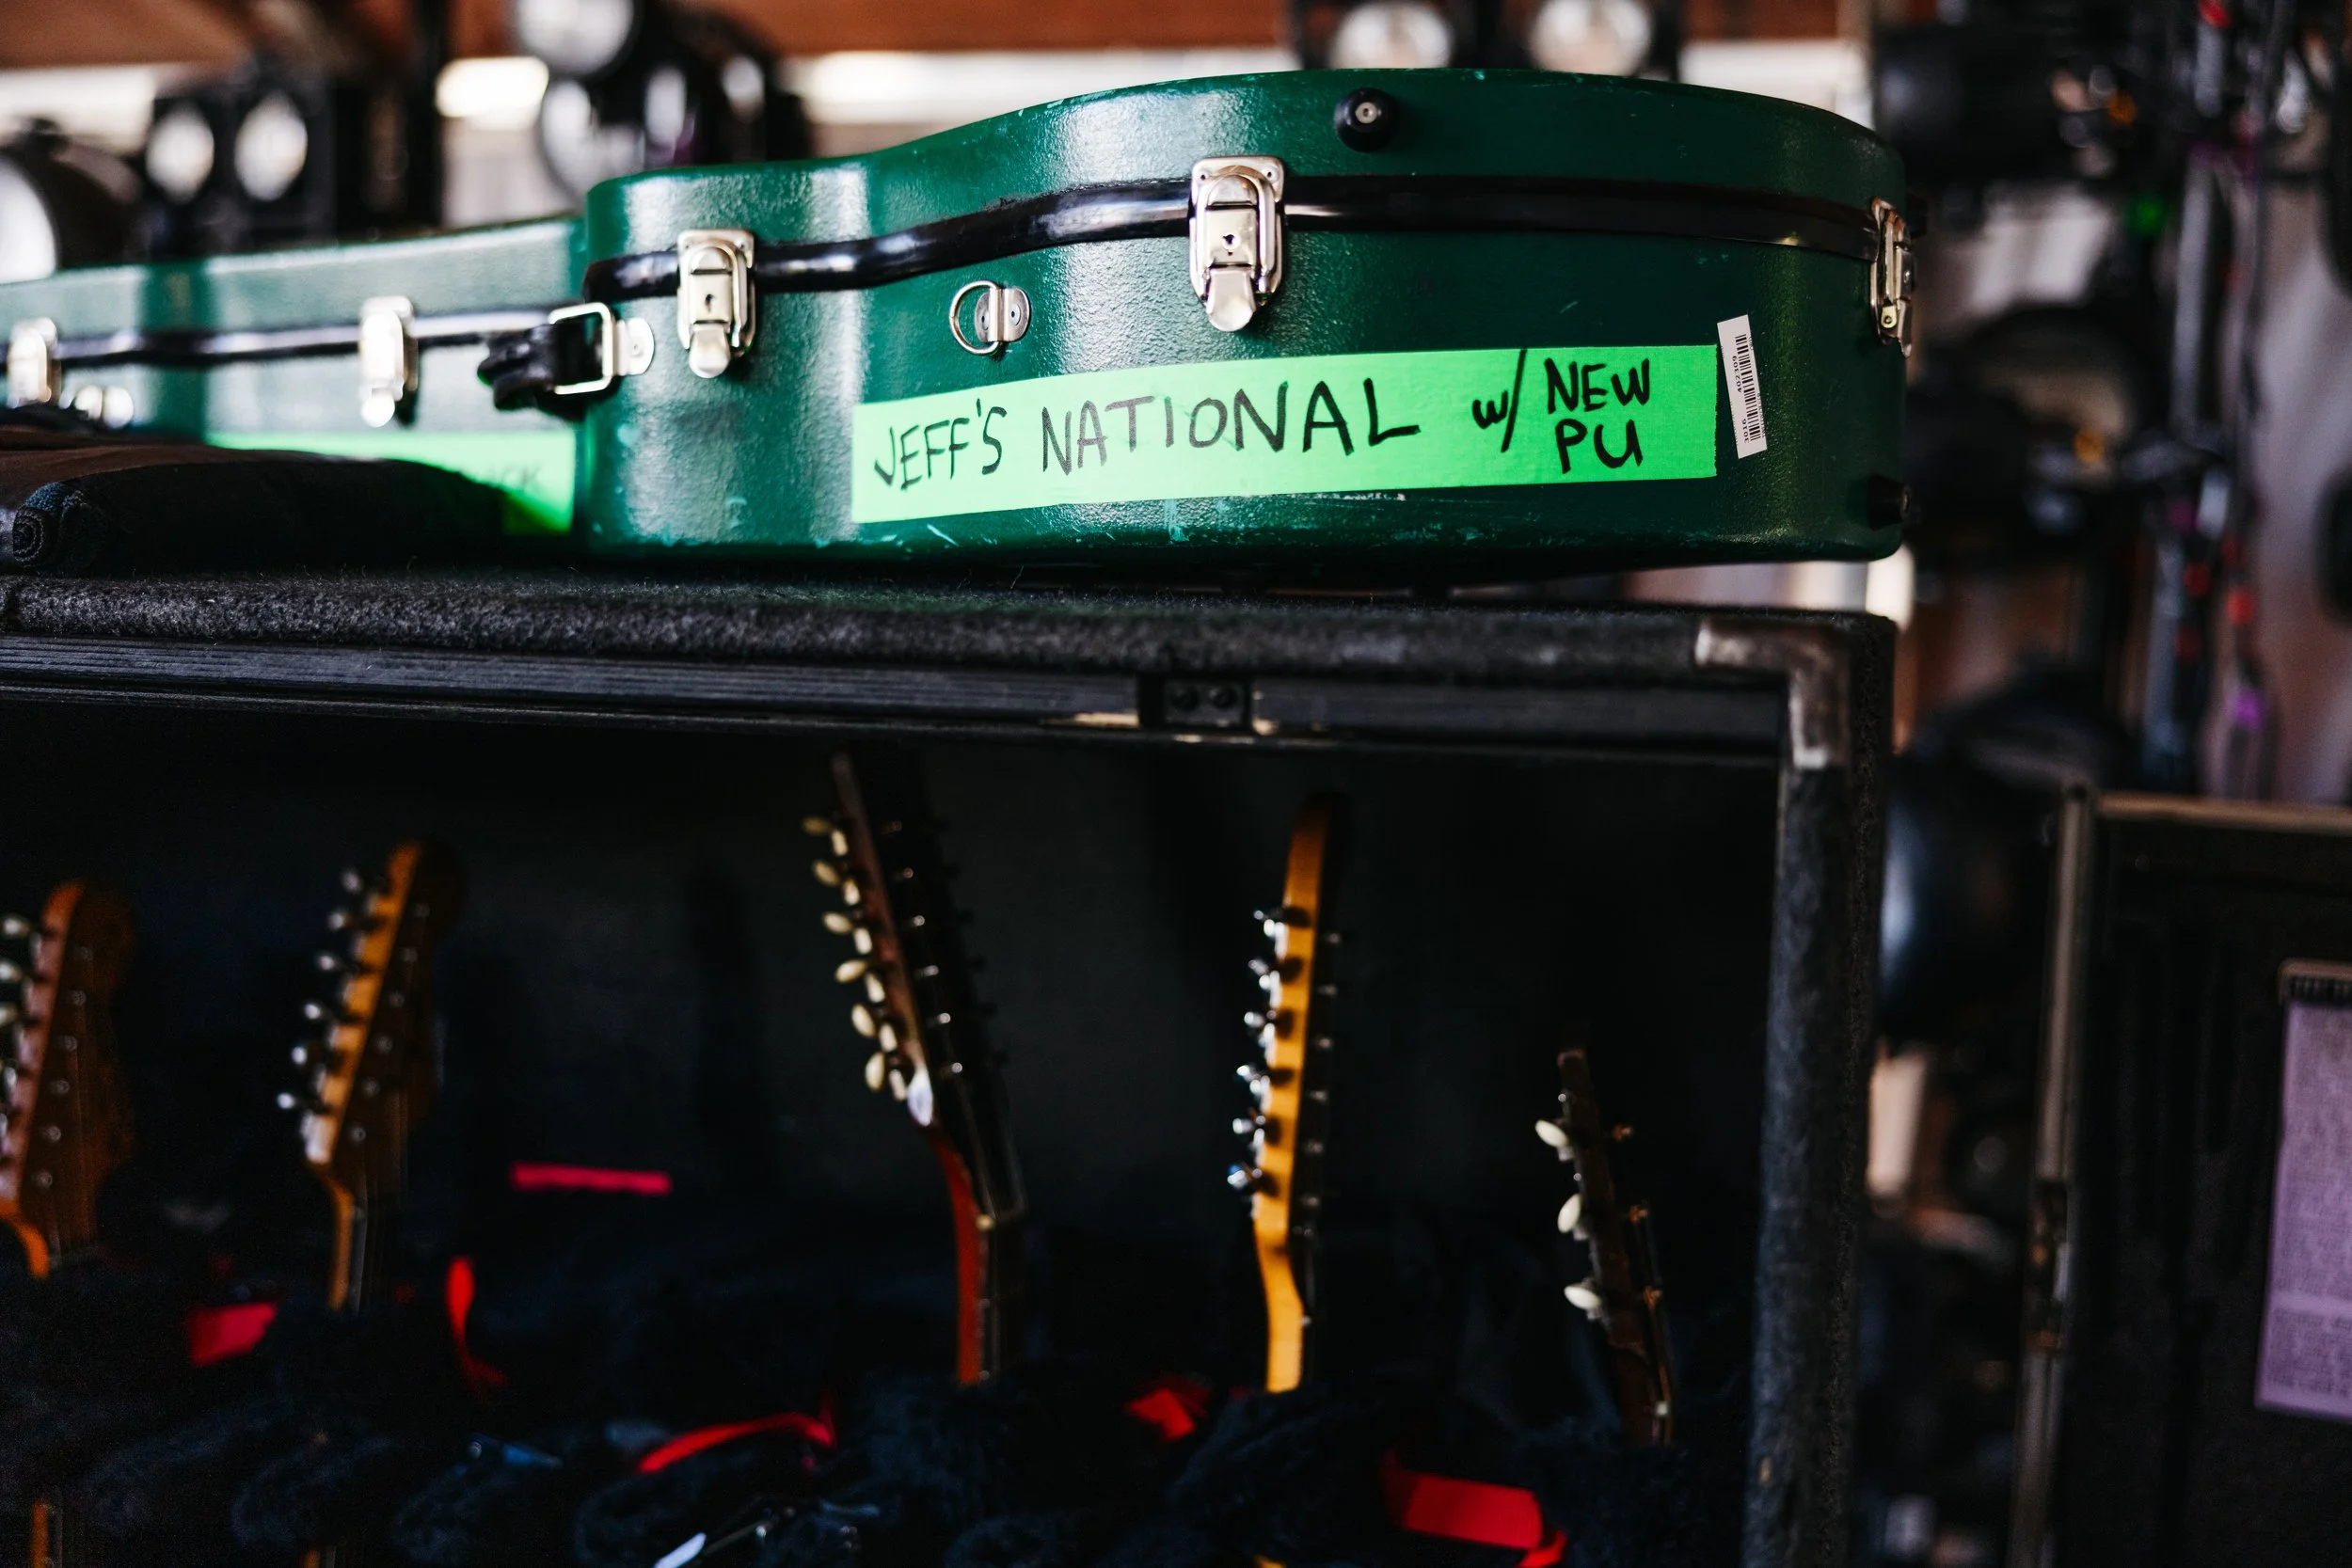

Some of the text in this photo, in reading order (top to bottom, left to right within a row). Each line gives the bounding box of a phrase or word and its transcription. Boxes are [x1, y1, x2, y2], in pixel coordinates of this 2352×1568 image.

[1546, 357, 1651, 415] NEW
[873, 349, 1528, 490] JEFF'S NATIONAL w/
[1554, 419, 1644, 473] PU
[1741, 419, 1750, 443] 3016
